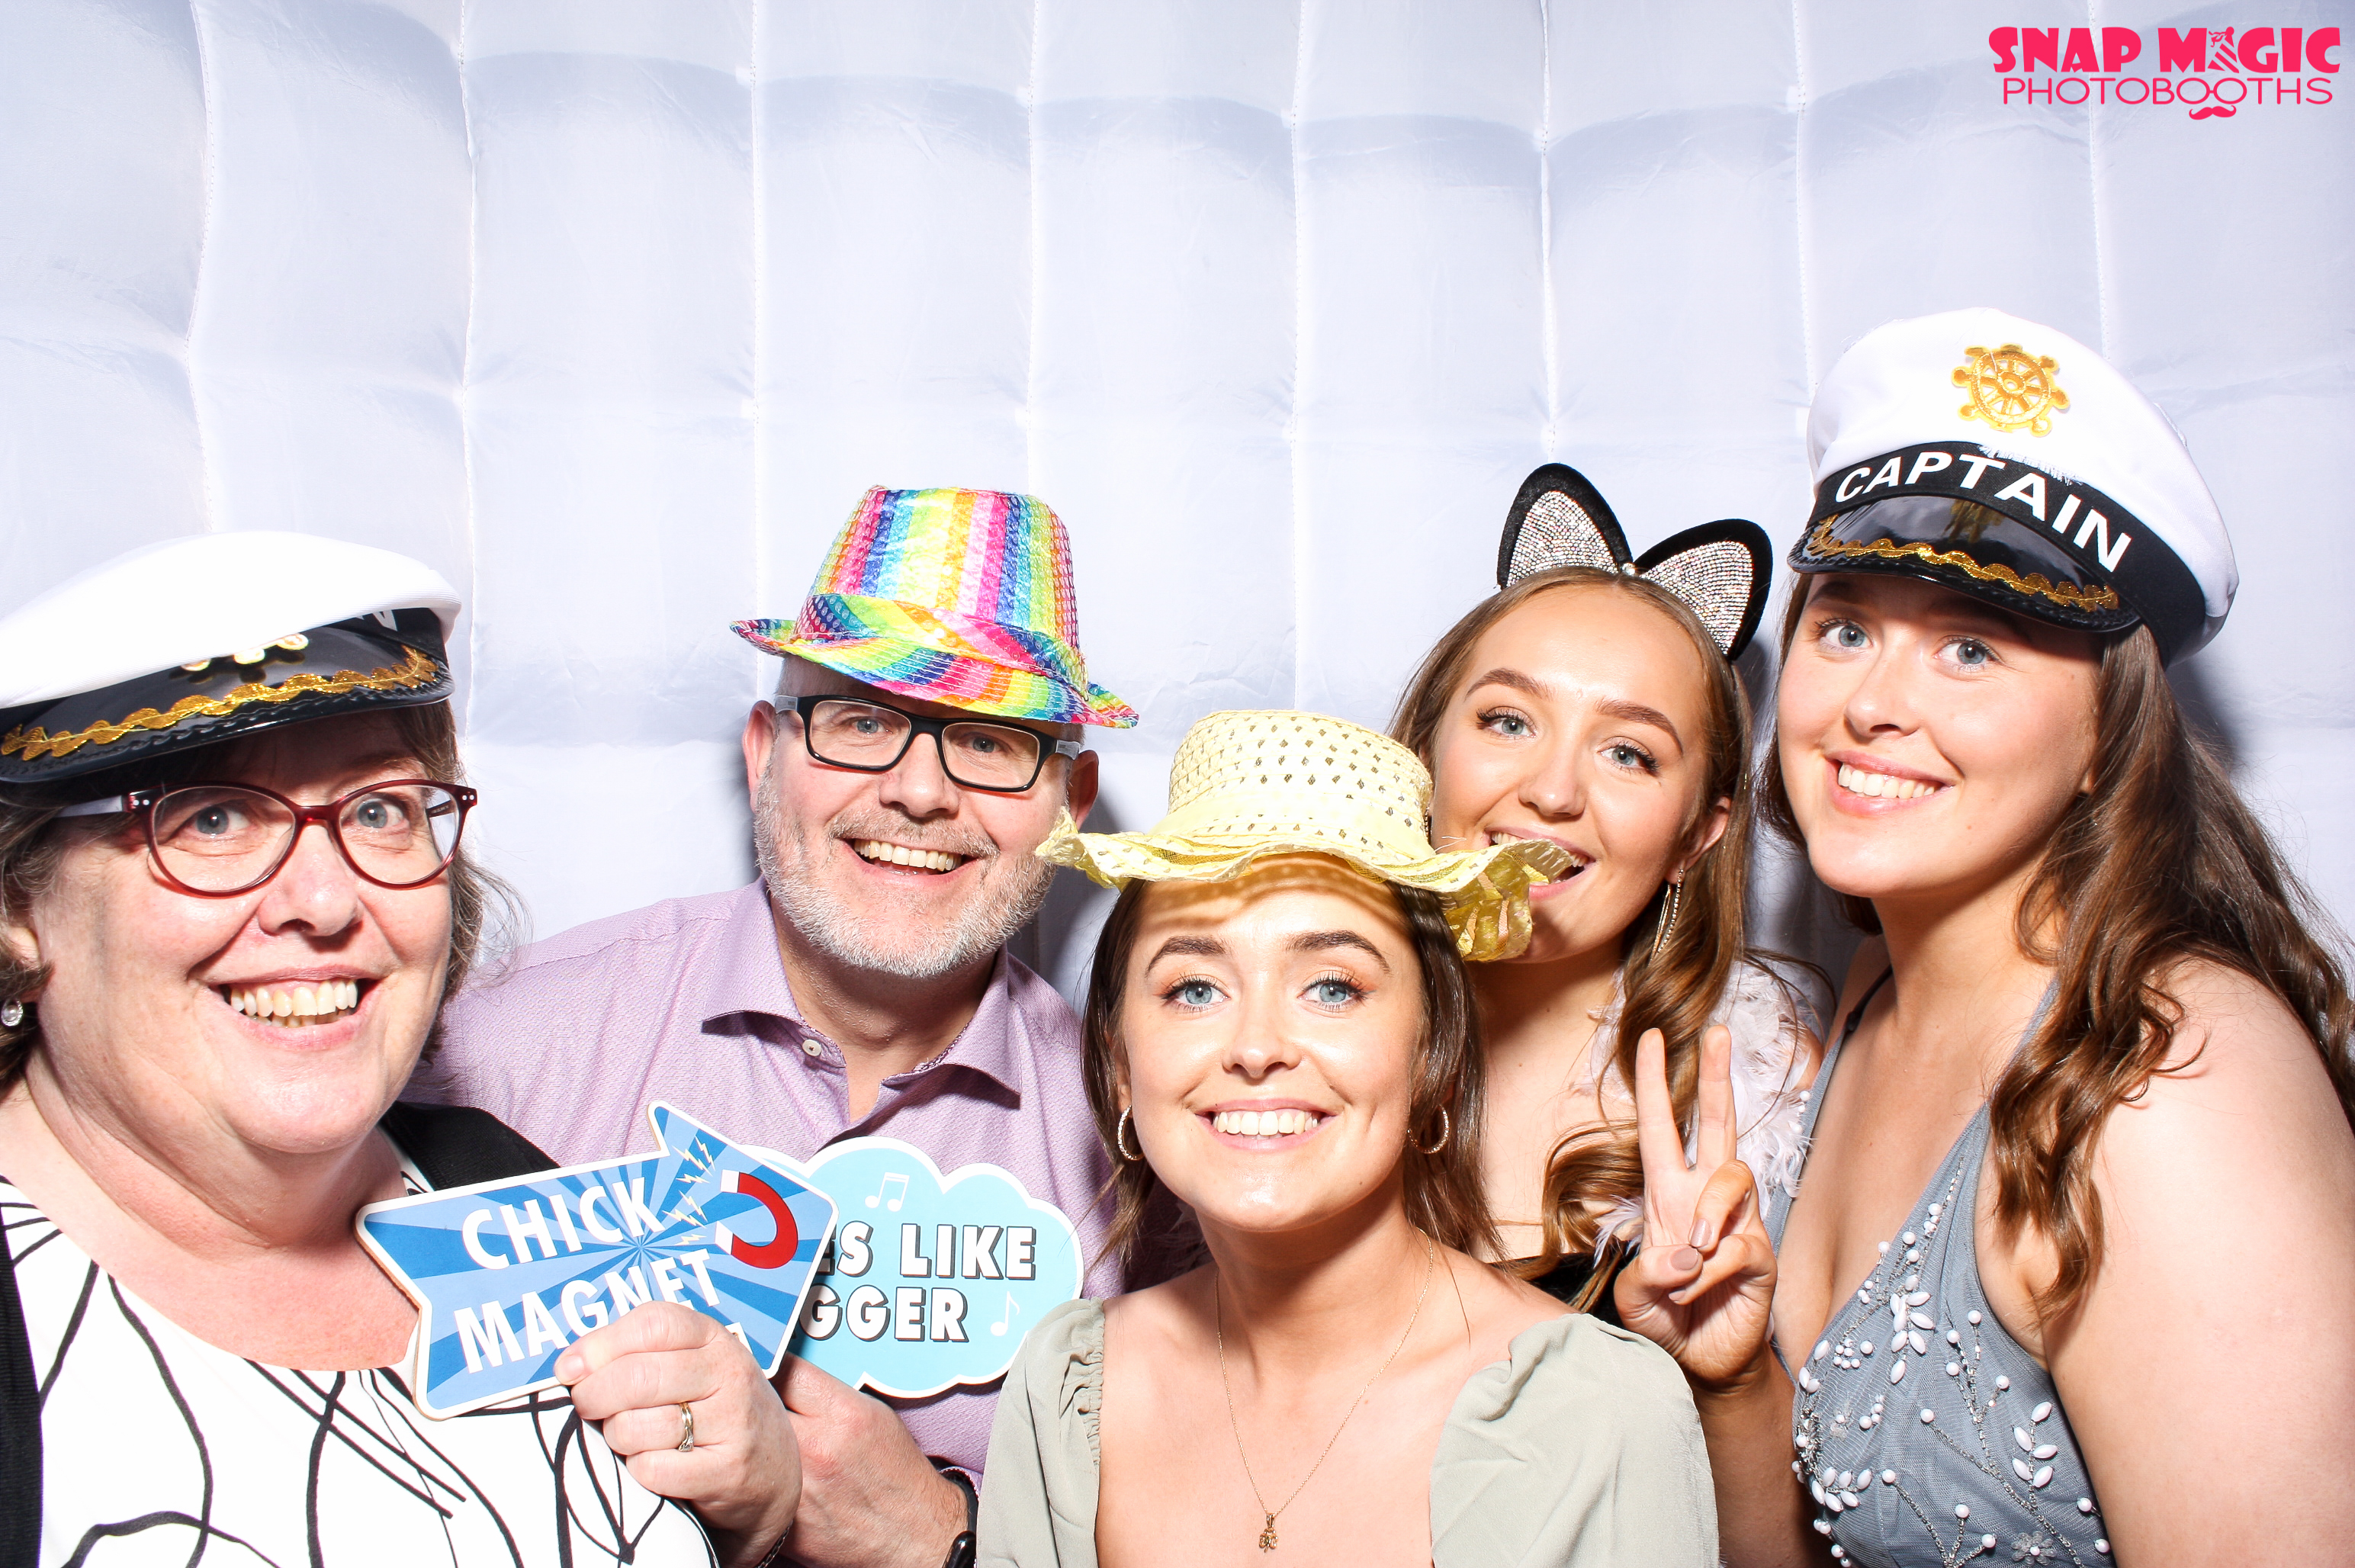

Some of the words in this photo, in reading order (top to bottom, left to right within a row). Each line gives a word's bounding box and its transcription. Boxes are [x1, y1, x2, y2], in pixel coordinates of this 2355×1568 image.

[1835, 451, 2133, 573] CAPTAIN
[461, 1177, 666, 1271] CHICK
[900, 1223, 1036, 1280] LIKE
[453, 1248, 721, 1375] MAGNET
[798, 1283, 969, 1343] GGER
